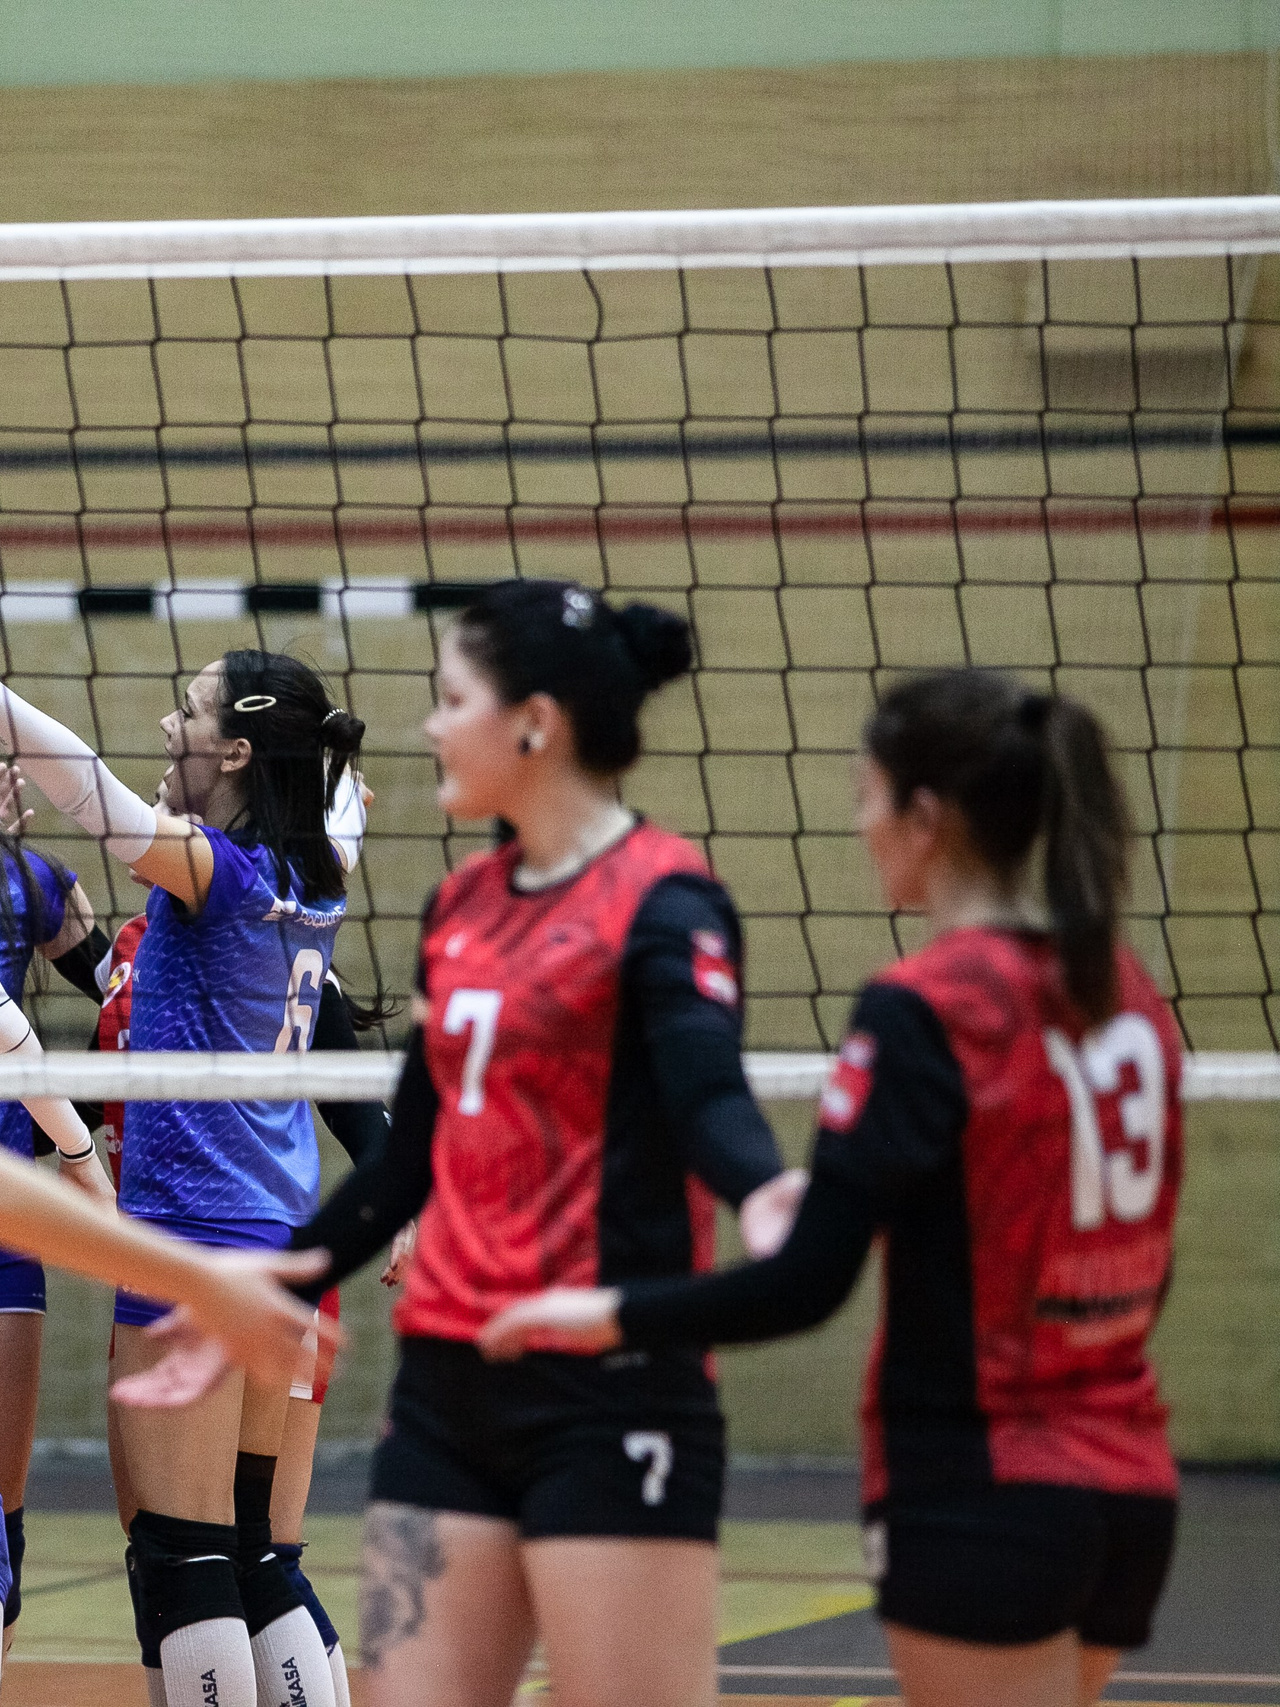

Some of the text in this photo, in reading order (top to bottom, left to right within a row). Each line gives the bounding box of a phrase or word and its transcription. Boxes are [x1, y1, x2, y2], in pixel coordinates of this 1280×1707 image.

[273, 948, 324, 1052] 6
[443, 987, 504, 1117] 7
[1042, 1011, 1166, 1231] 13
[622, 1429, 674, 1507] 7
[200, 1668, 219, 1707] ASA
